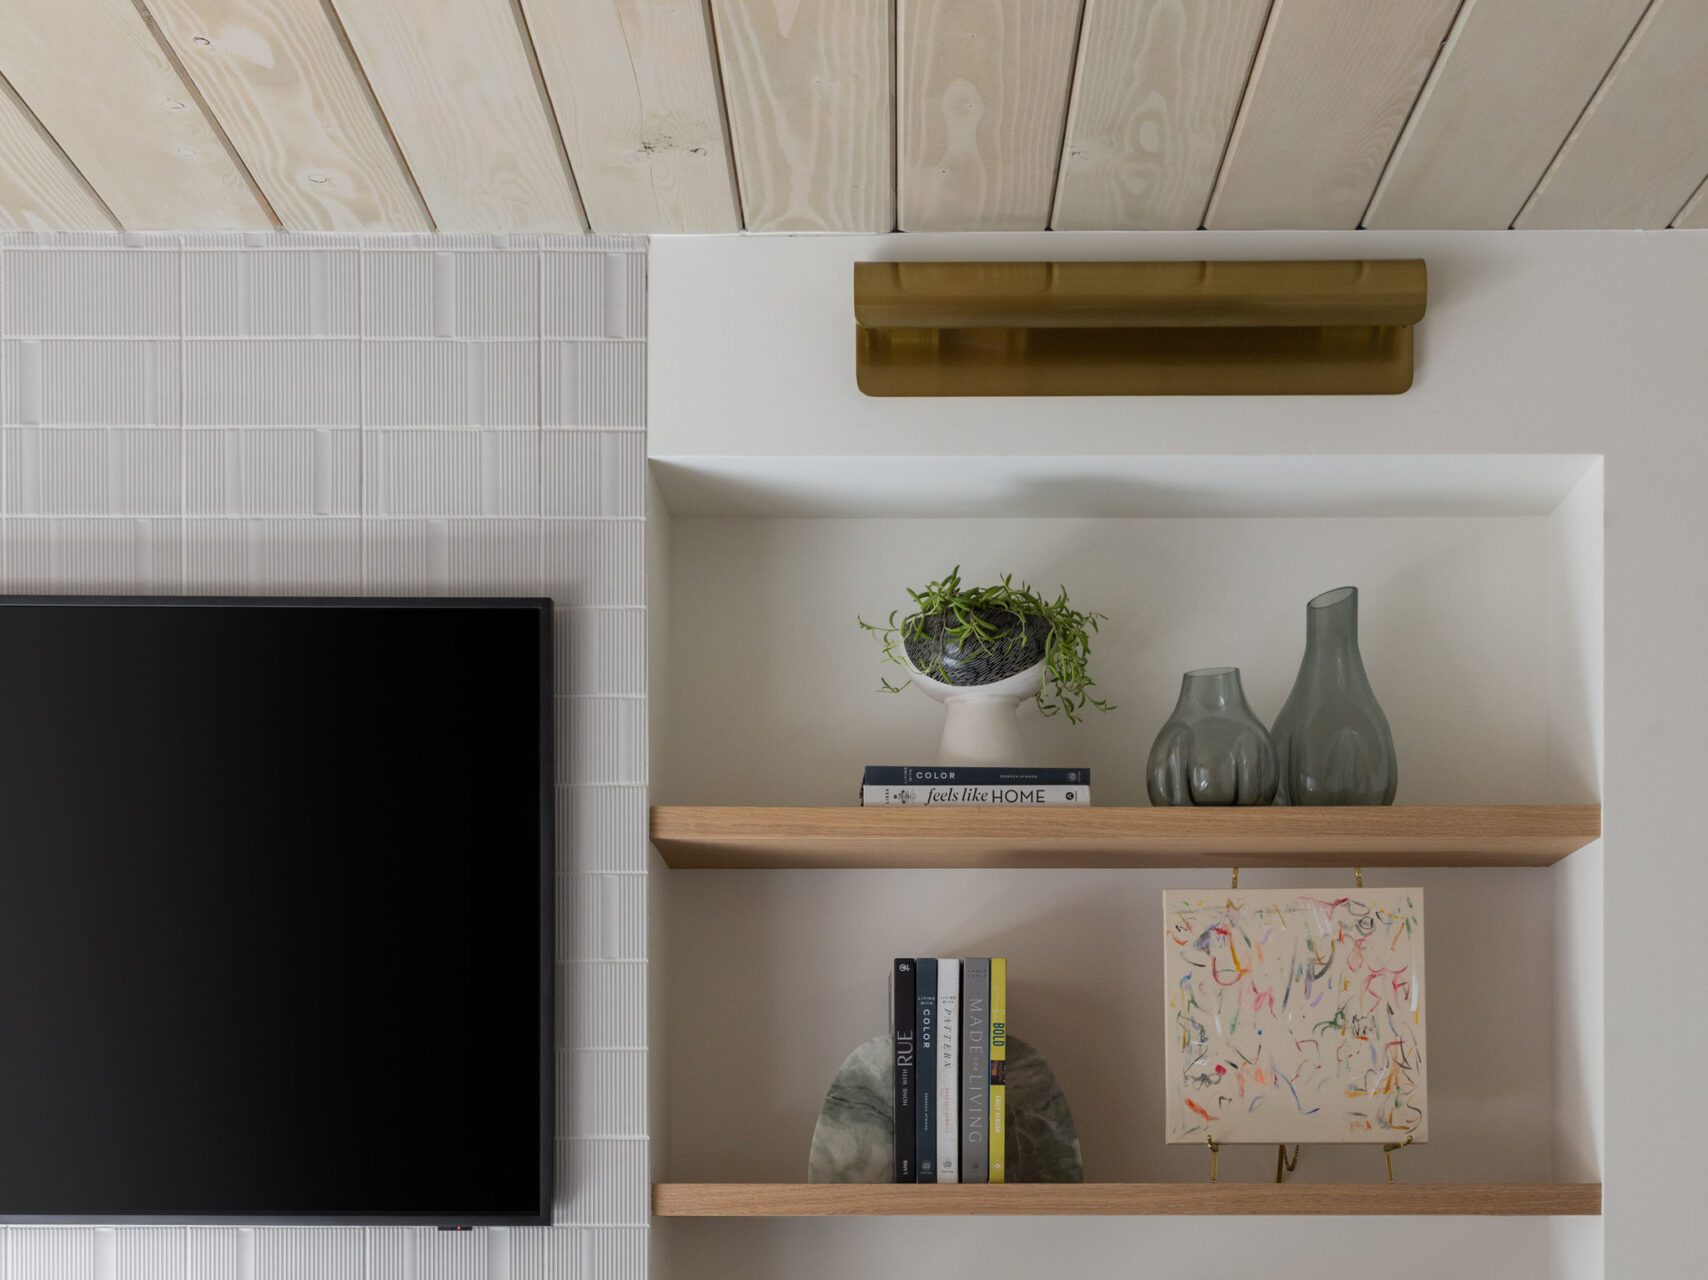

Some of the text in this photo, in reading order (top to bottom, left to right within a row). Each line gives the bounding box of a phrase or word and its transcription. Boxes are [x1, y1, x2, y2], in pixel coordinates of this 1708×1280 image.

[916, 771, 956, 780] COLOR
[924, 787, 1046, 806] feels like HOME
[943, 1008, 952, 1069] PATTERN
[968, 998, 983, 1054] MADE
[992, 1022, 1005, 1047] BOLD
[897, 1030, 913, 1066] RUE
[968, 1075, 982, 1143] LIVING
